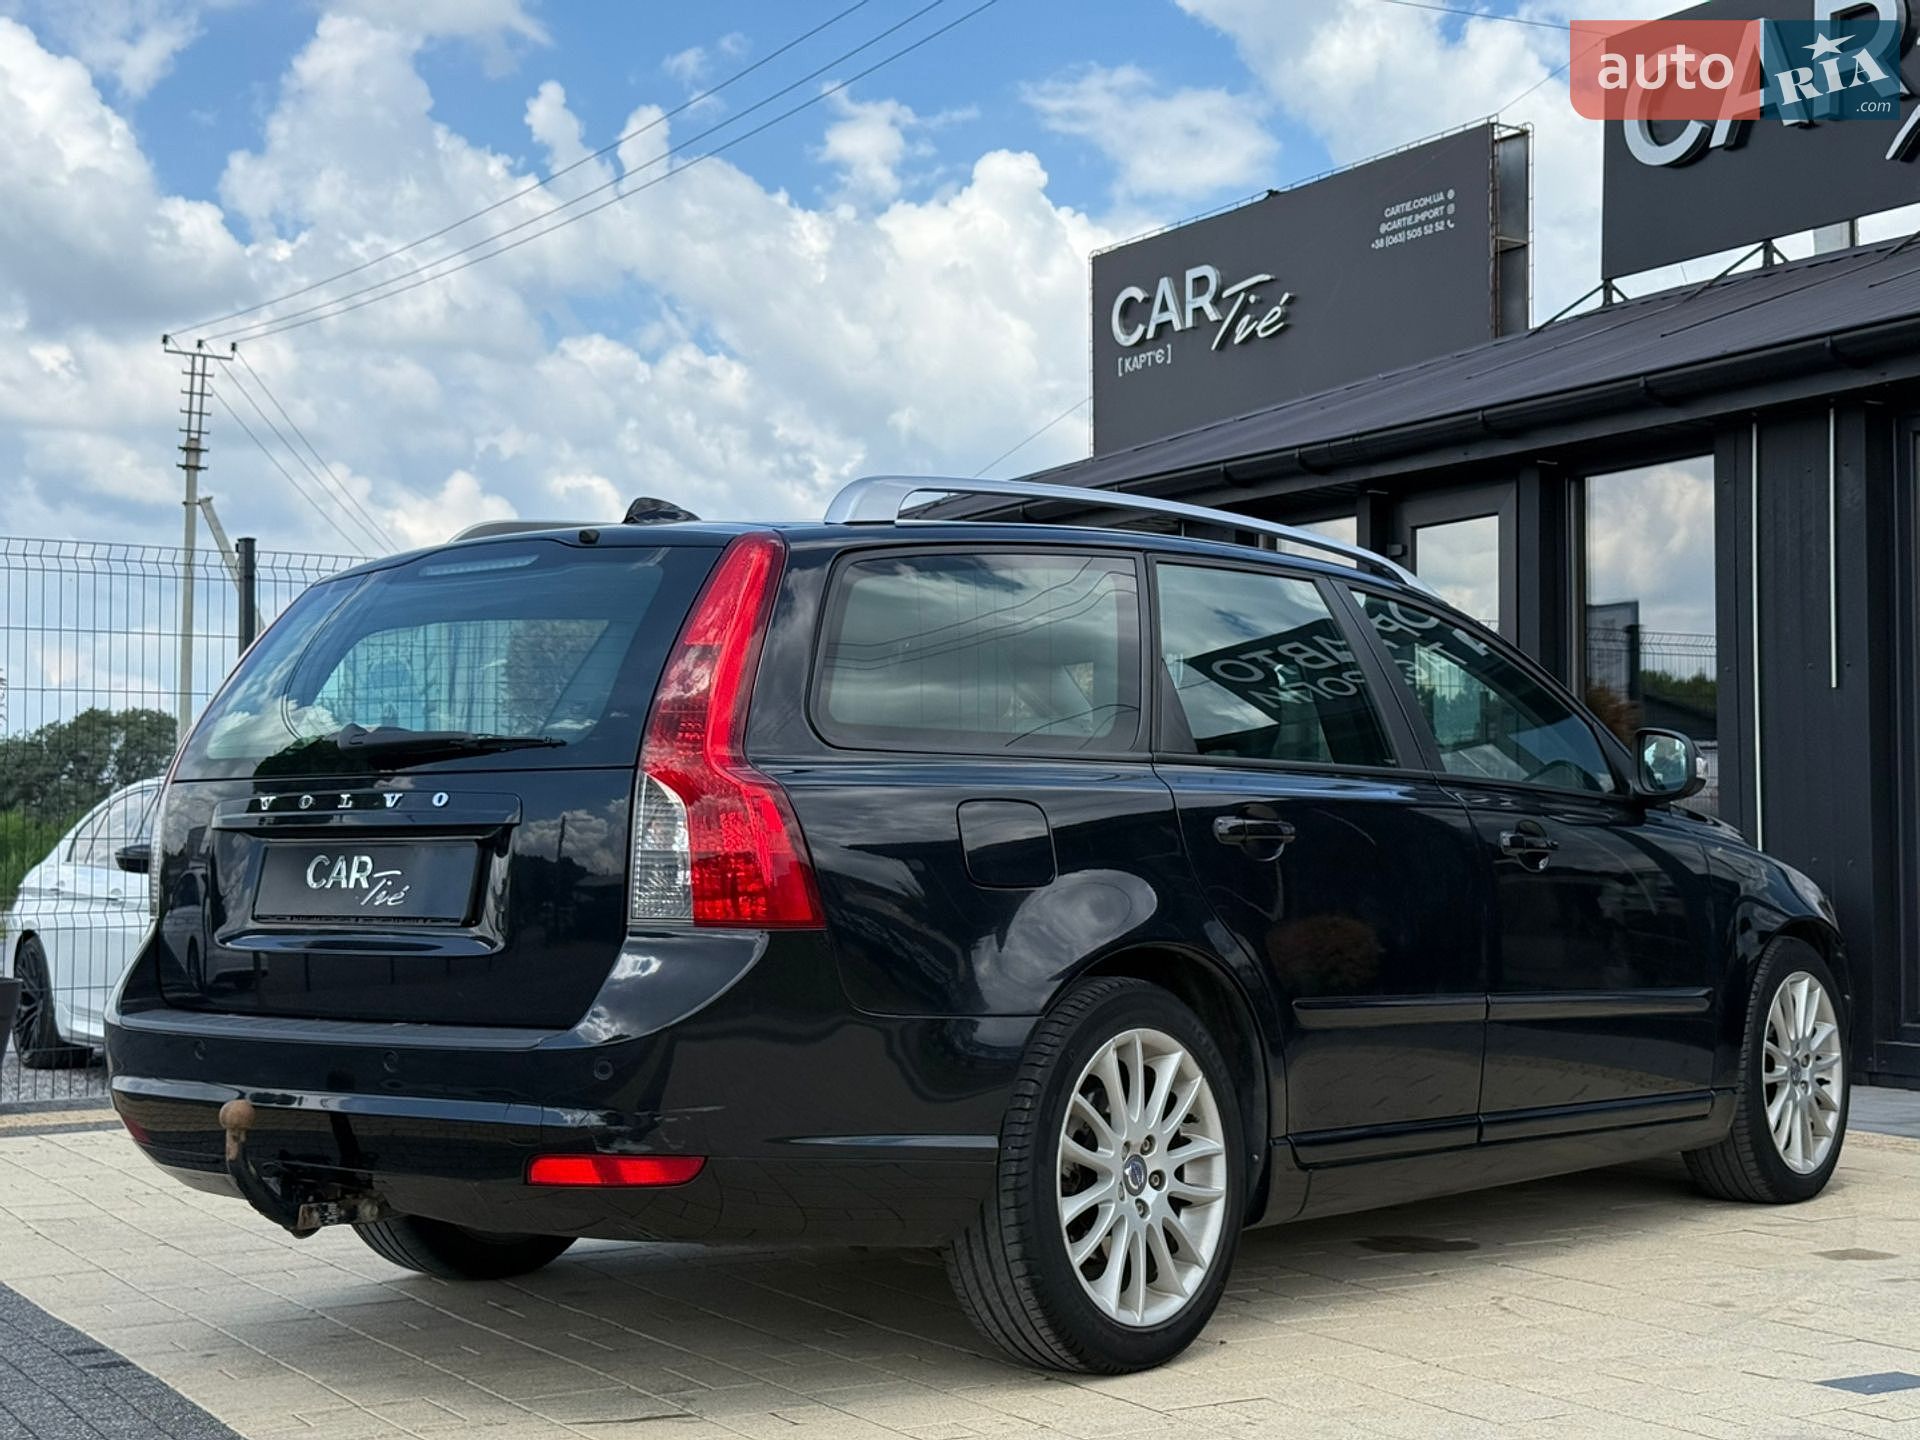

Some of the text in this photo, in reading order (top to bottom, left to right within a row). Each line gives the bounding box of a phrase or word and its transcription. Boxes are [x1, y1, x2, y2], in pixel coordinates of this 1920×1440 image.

[1384, 191, 1445, 218] CARTIE.COM.UA
[1406, 226, 1422, 240] 505
[1423, 223, 1434, 235] 52
[1434, 220, 1445, 232] 52
[1111, 264, 1223, 347] CAR
[259, 792, 449, 811] VOLVO
[306, 854, 374, 889] CAR
